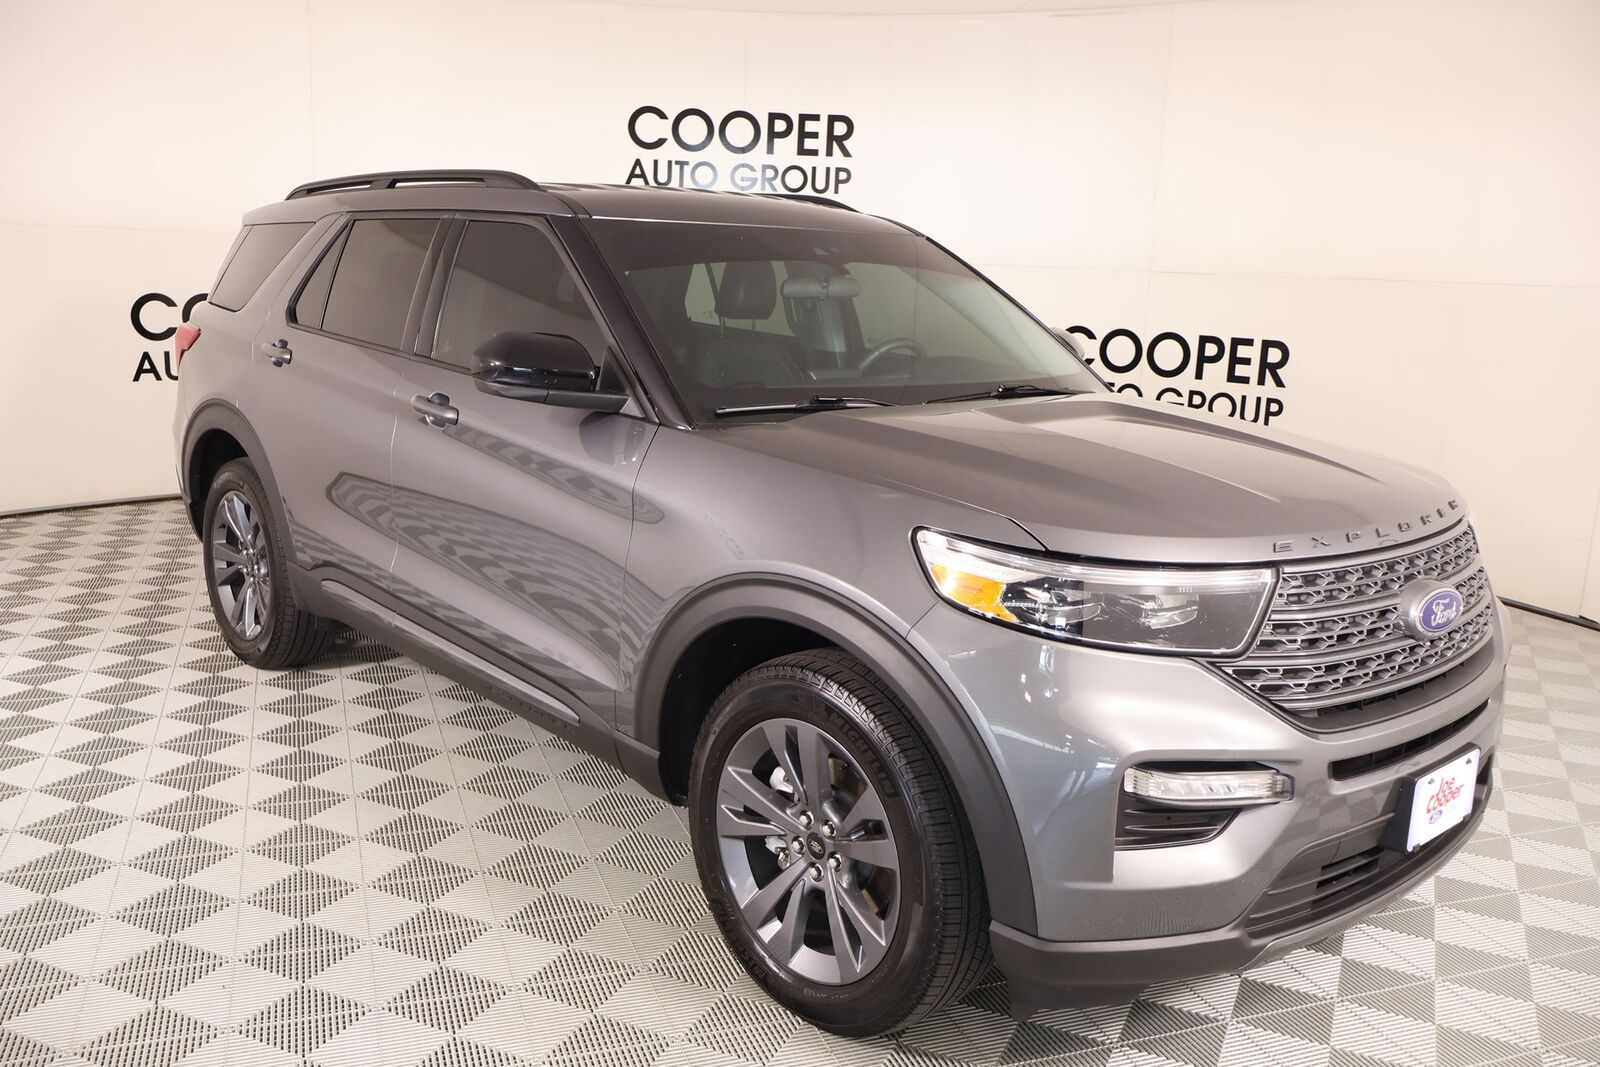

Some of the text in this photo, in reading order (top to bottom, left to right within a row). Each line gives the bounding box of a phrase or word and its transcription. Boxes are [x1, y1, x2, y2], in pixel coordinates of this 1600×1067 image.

[627, 105, 855, 158] COOPER
[625, 158, 852, 194] AUTO GROUP
[1431, 598, 1457, 626] Ford
